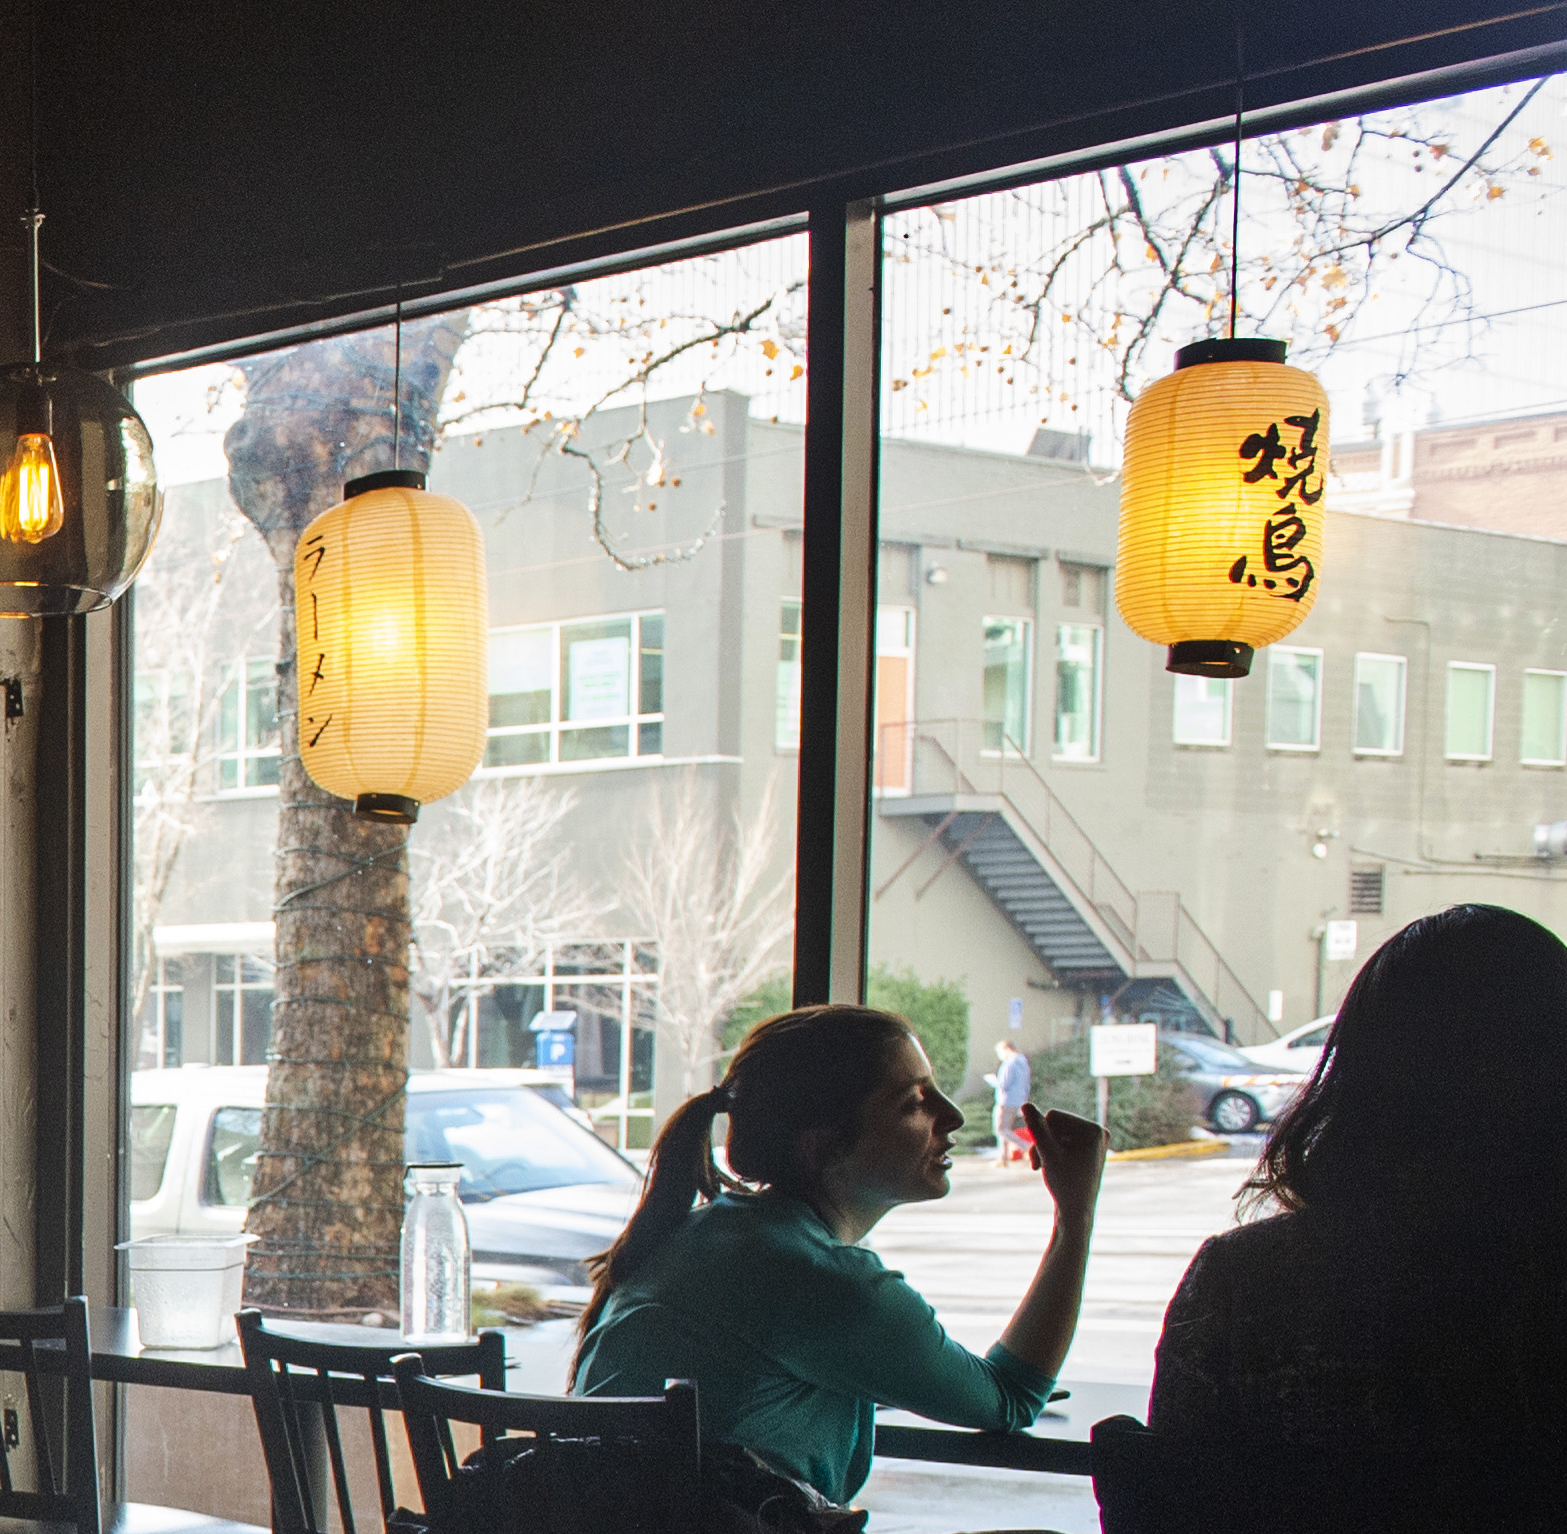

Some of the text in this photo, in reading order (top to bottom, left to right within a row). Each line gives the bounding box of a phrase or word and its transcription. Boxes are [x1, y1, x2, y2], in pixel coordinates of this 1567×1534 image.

[1229, 407, 1324, 602] 焼鳥
[303, 535, 333, 747] ラーメン
